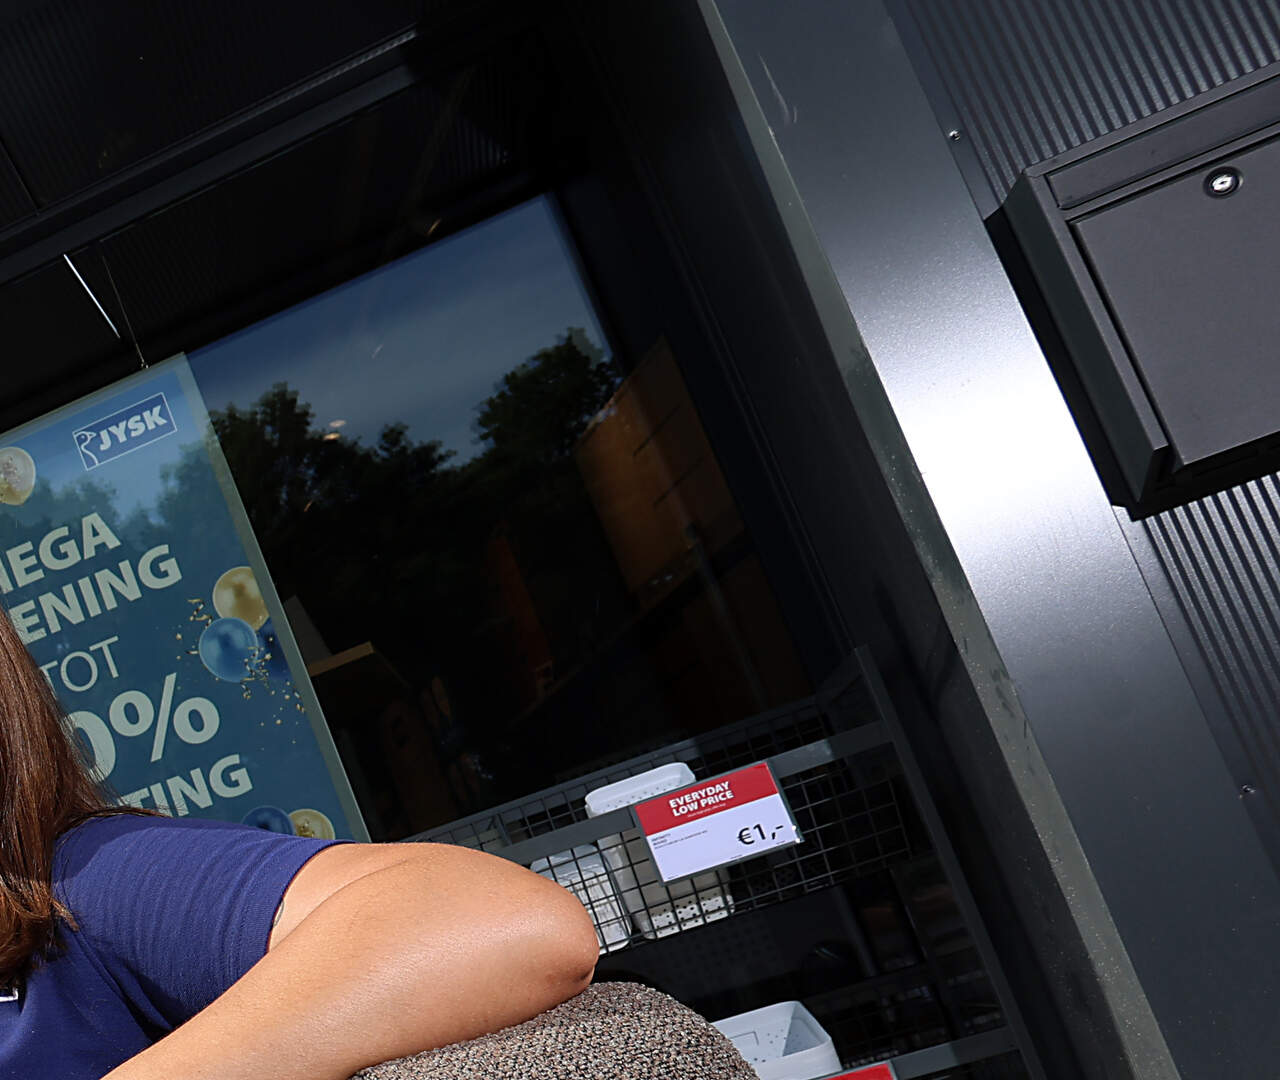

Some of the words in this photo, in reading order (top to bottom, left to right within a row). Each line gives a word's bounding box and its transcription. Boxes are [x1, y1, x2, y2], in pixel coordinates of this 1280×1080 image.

[99, 404, 168, 451] JYSK
[8, 544, 183, 646] ENING
[60, 672, 220, 784] 0%
[117, 754, 253, 818] TING
[668, 781, 731, 808] EVERYDAY
[672, 801, 701, 817] LOW
[702, 790, 735, 808] PRICE
[737, 823, 784, 845] €1,-
